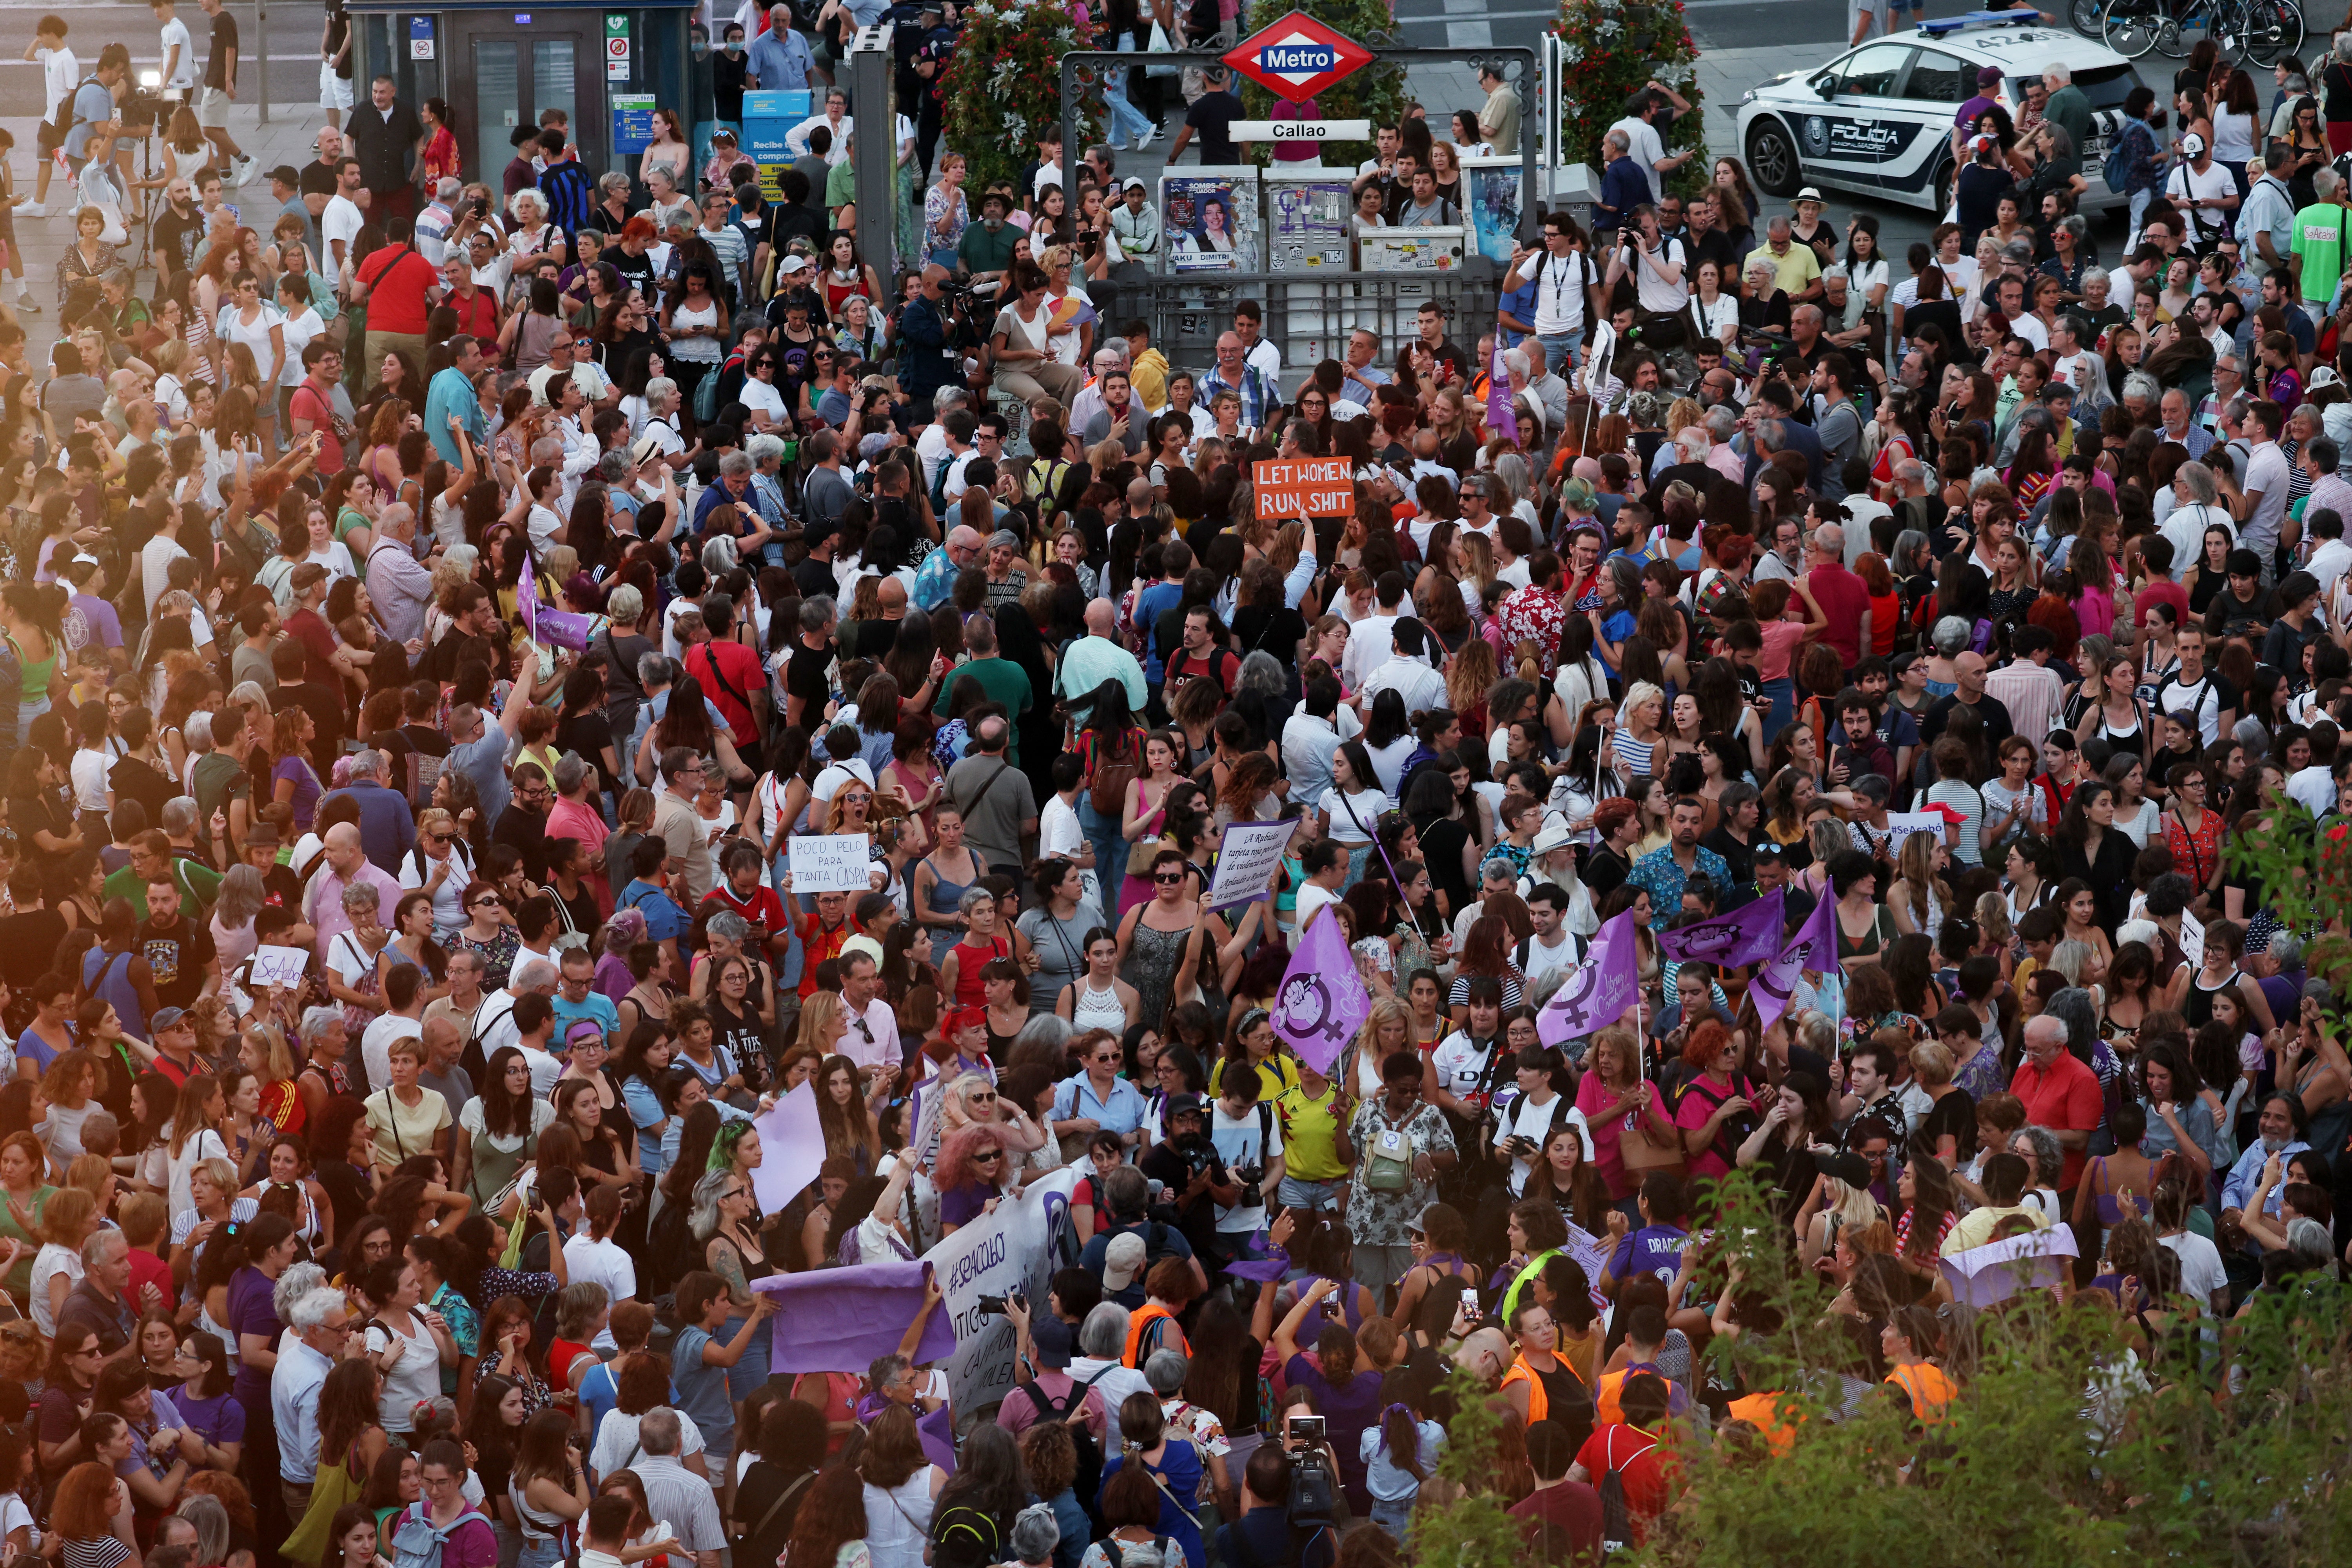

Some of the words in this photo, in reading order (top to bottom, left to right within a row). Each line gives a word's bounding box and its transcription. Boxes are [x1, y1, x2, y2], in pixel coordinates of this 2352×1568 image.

[1267, 50, 1329, 67] Metro
[1273, 124, 1326, 137] Callao
[1325, 250, 1343, 263] TM54
[1259, 465, 1293, 485] LET
[1297, 462, 1351, 483] WOMEN
[1261, 492, 1301, 515] RUN
[1308, 492, 1351, 512] SHIT
[1255, 831, 1279, 843] Rubiales
[796, 842, 826, 855] POCO
[837, 840, 862, 852] PELO
[1228, 848, 1250, 860] tarjeta
[1250, 846, 1261, 858] roja
[1262, 846, 1272, 857] por
[818, 857, 842, 866] PARA
[1227, 861, 1234, 871] de
[1236, 859, 1259, 870] violencia
[796, 871, 830, 882] TANTA
[837, 867, 867, 886] CASPA
[1250, 867, 1271, 881] Rubiales
[1223, 889, 1242, 900] aceptar
[727, 1031, 761, 1054] BETLES
[954, 1306, 989, 1341] TIGO
